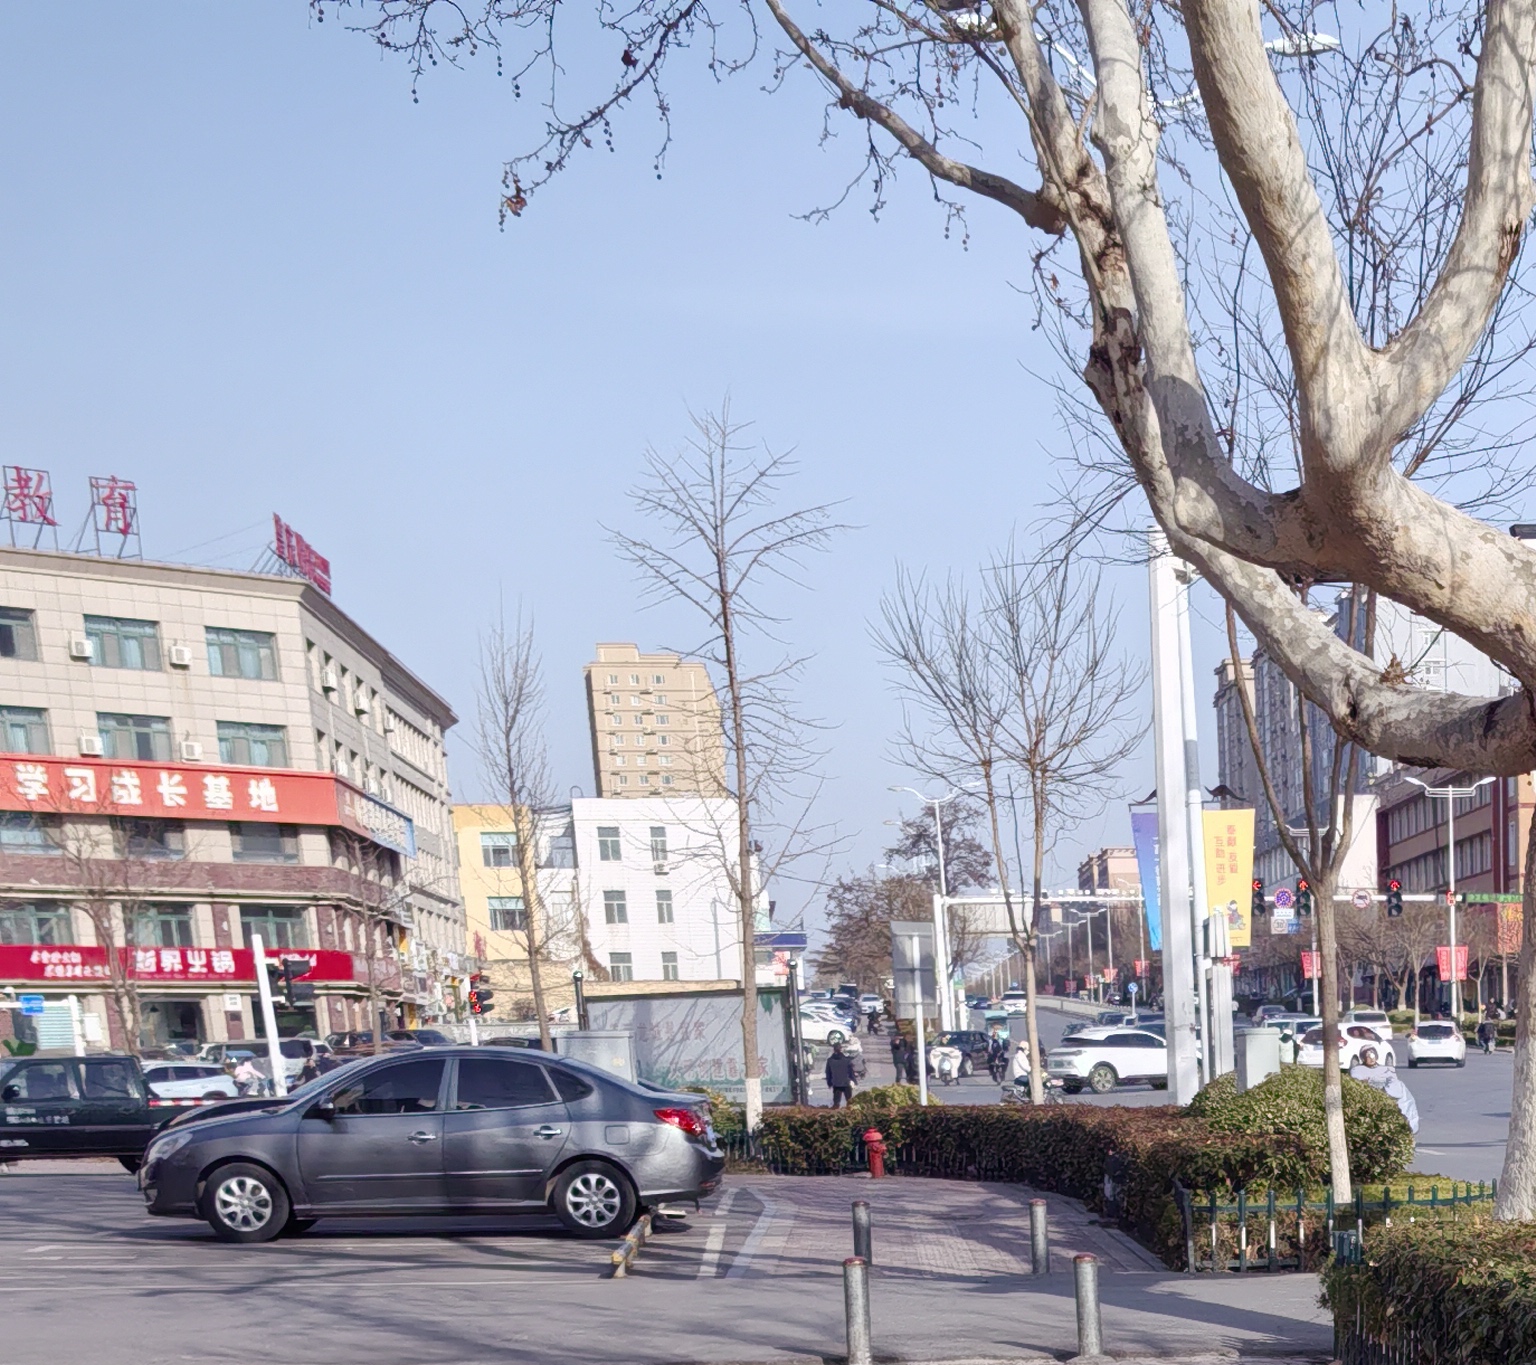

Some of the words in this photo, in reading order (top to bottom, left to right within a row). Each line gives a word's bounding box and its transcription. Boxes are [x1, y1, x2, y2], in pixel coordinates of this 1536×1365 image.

[4, 465, 138, 536] 教育
[15, 763, 279, 812] 学习成长基地
